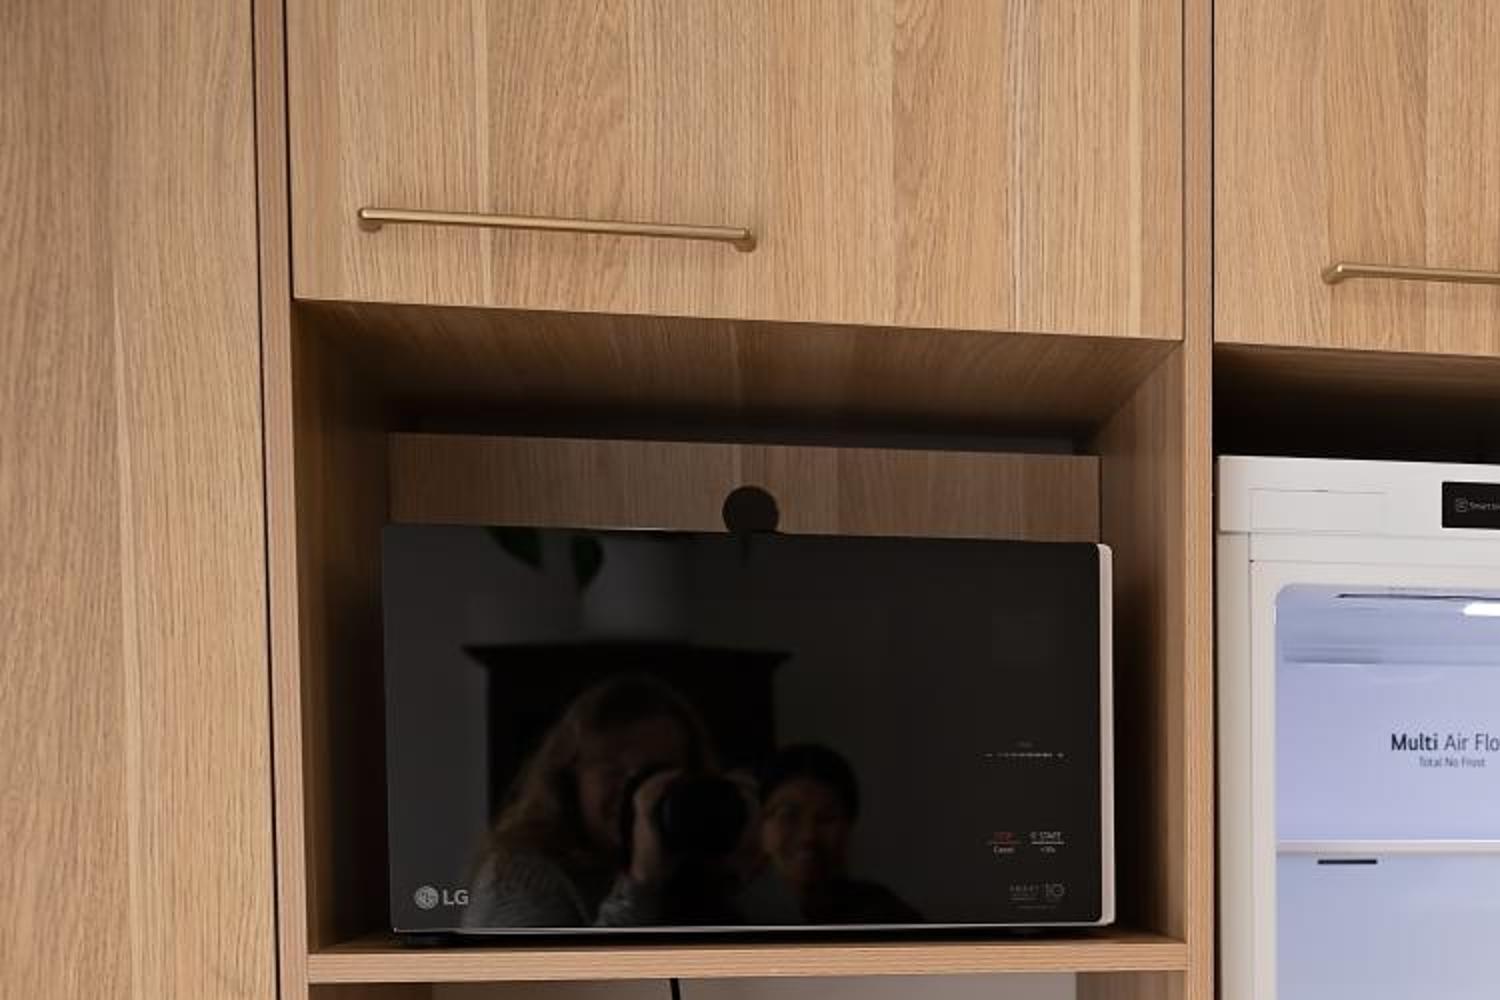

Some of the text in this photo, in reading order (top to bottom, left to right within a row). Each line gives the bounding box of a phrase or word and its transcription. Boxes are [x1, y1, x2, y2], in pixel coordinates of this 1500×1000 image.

[1391, 733, 1439, 751] Multi
[1443, 732, 1470, 751] Air
[443, 889, 470, 905] LG
